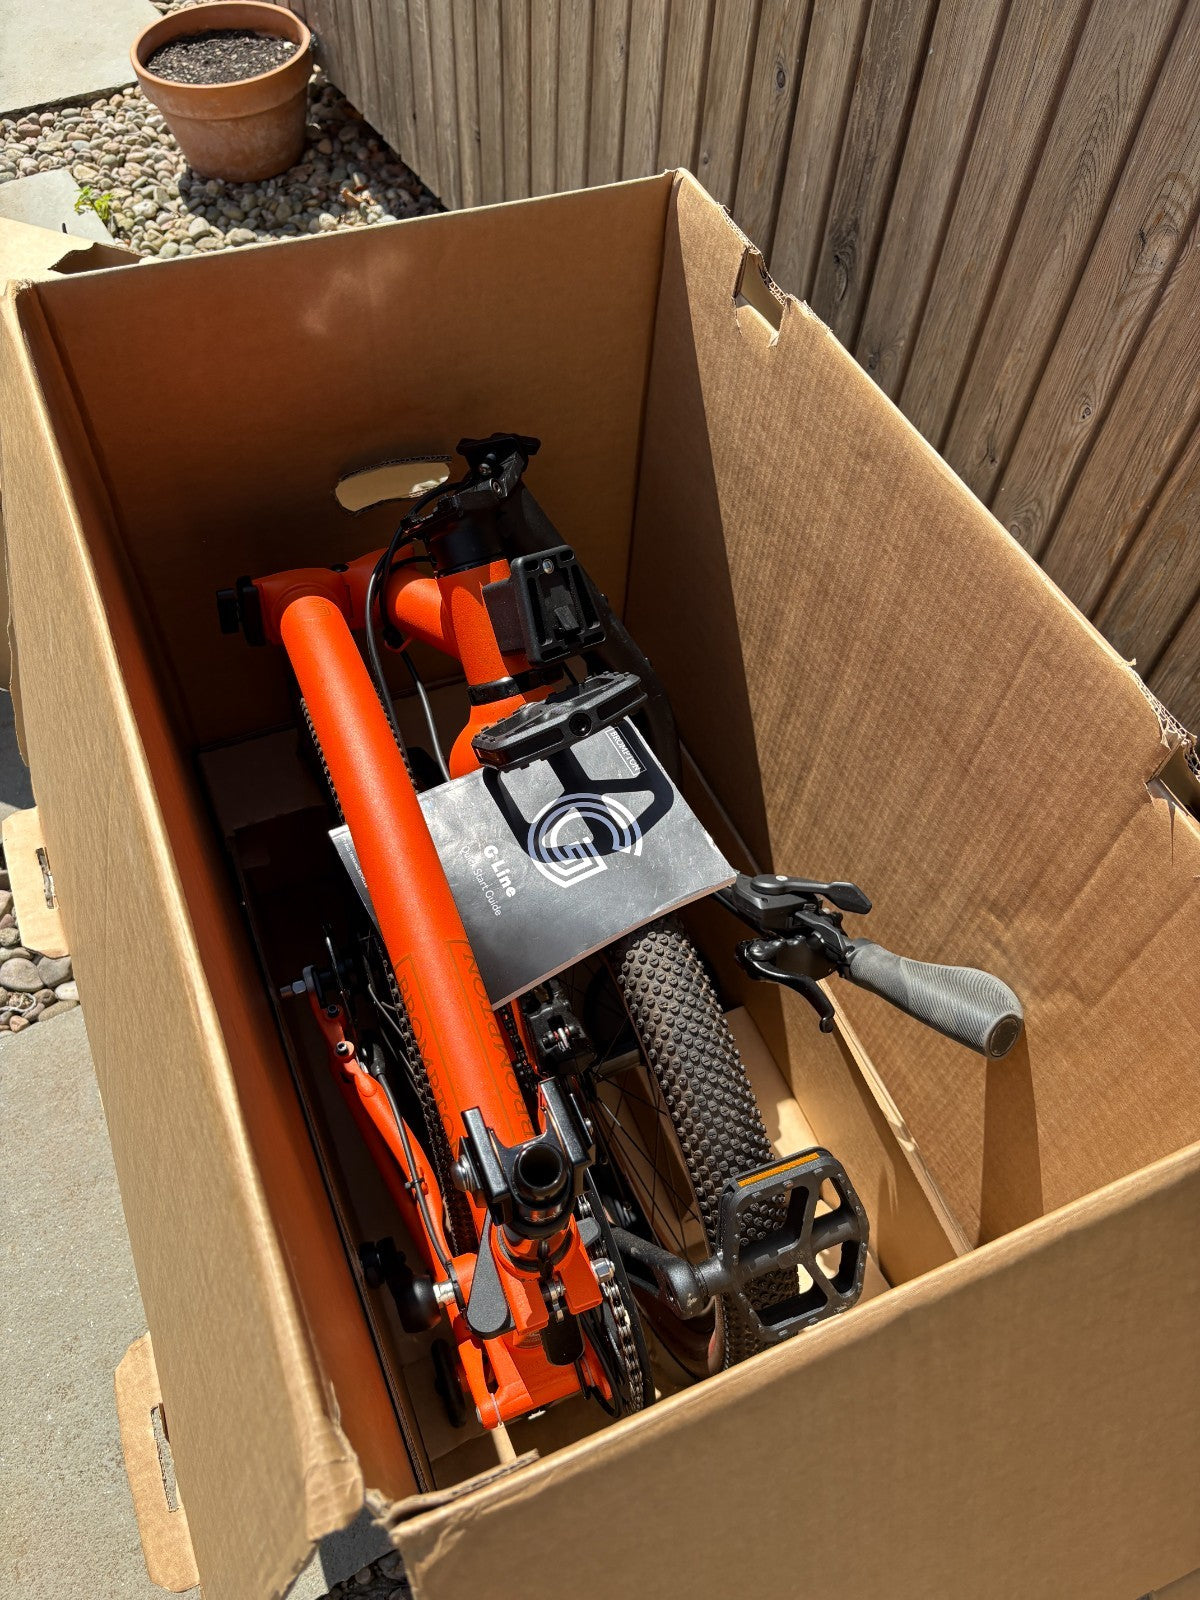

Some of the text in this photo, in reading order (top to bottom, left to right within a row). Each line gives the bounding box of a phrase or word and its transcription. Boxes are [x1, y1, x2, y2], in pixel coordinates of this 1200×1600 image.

[609, 731, 642, 771] BROMPTON
[460, 845, 502, 916] Quick Start Guide
[483, 845, 516, 898] G Line
